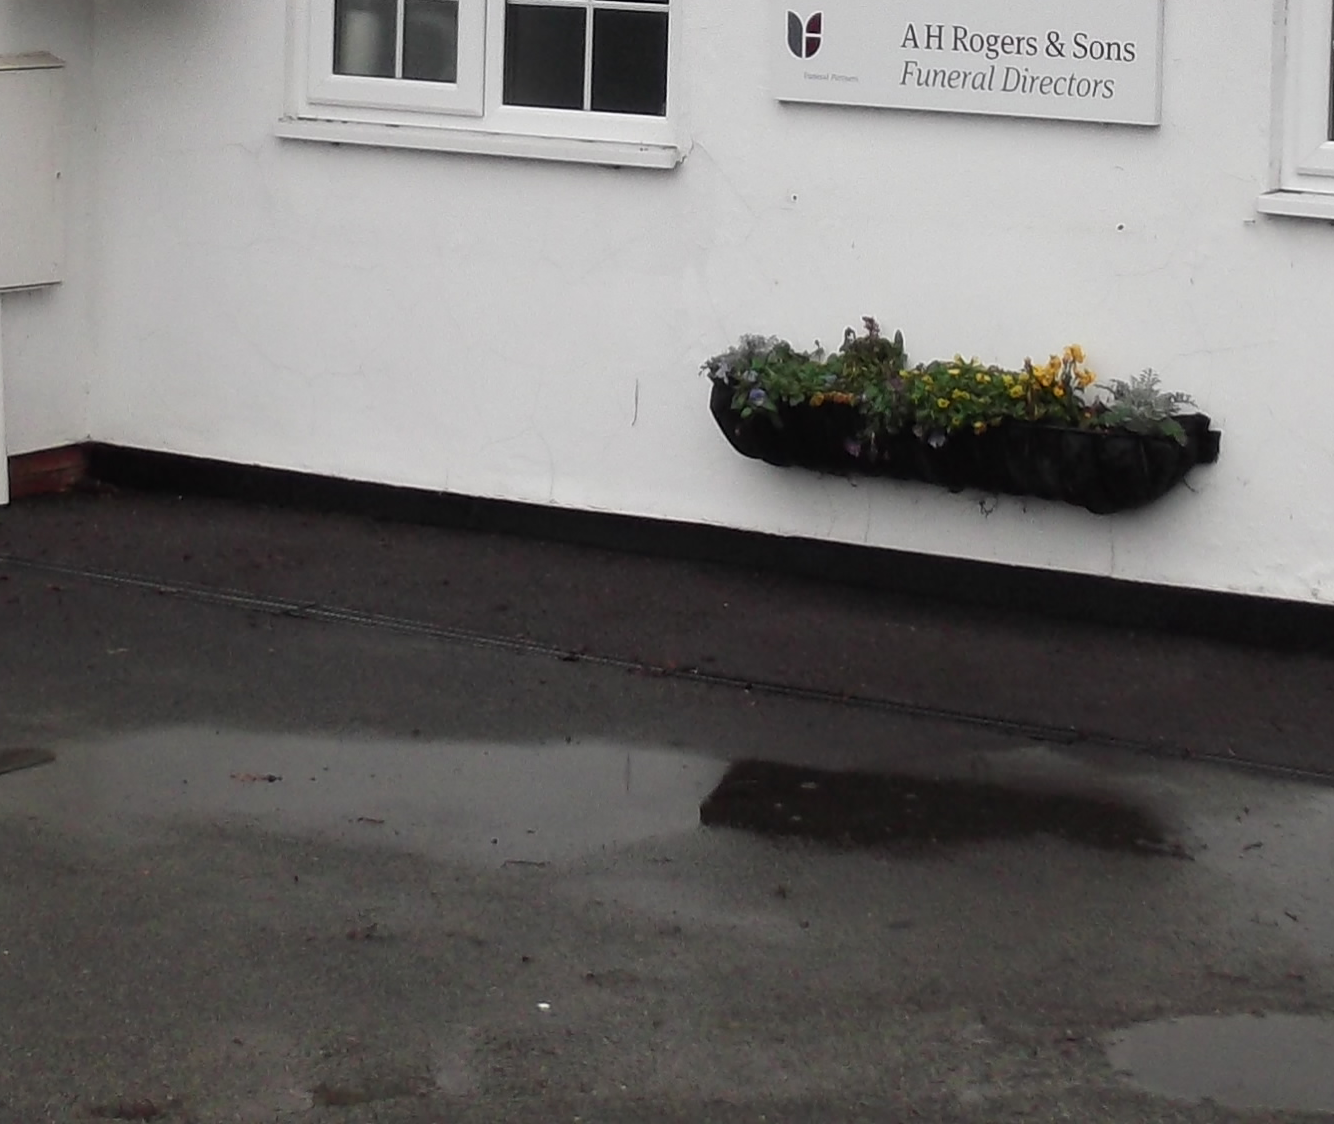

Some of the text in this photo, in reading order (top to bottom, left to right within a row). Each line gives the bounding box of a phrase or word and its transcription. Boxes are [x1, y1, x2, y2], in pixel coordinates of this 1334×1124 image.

[951, 25, 1038, 60] Rogers
[1045, 31, 1066, 58] &
[1072, 32, 1136, 62] Sons
[899, 60, 1115, 99] Funeral Directors
